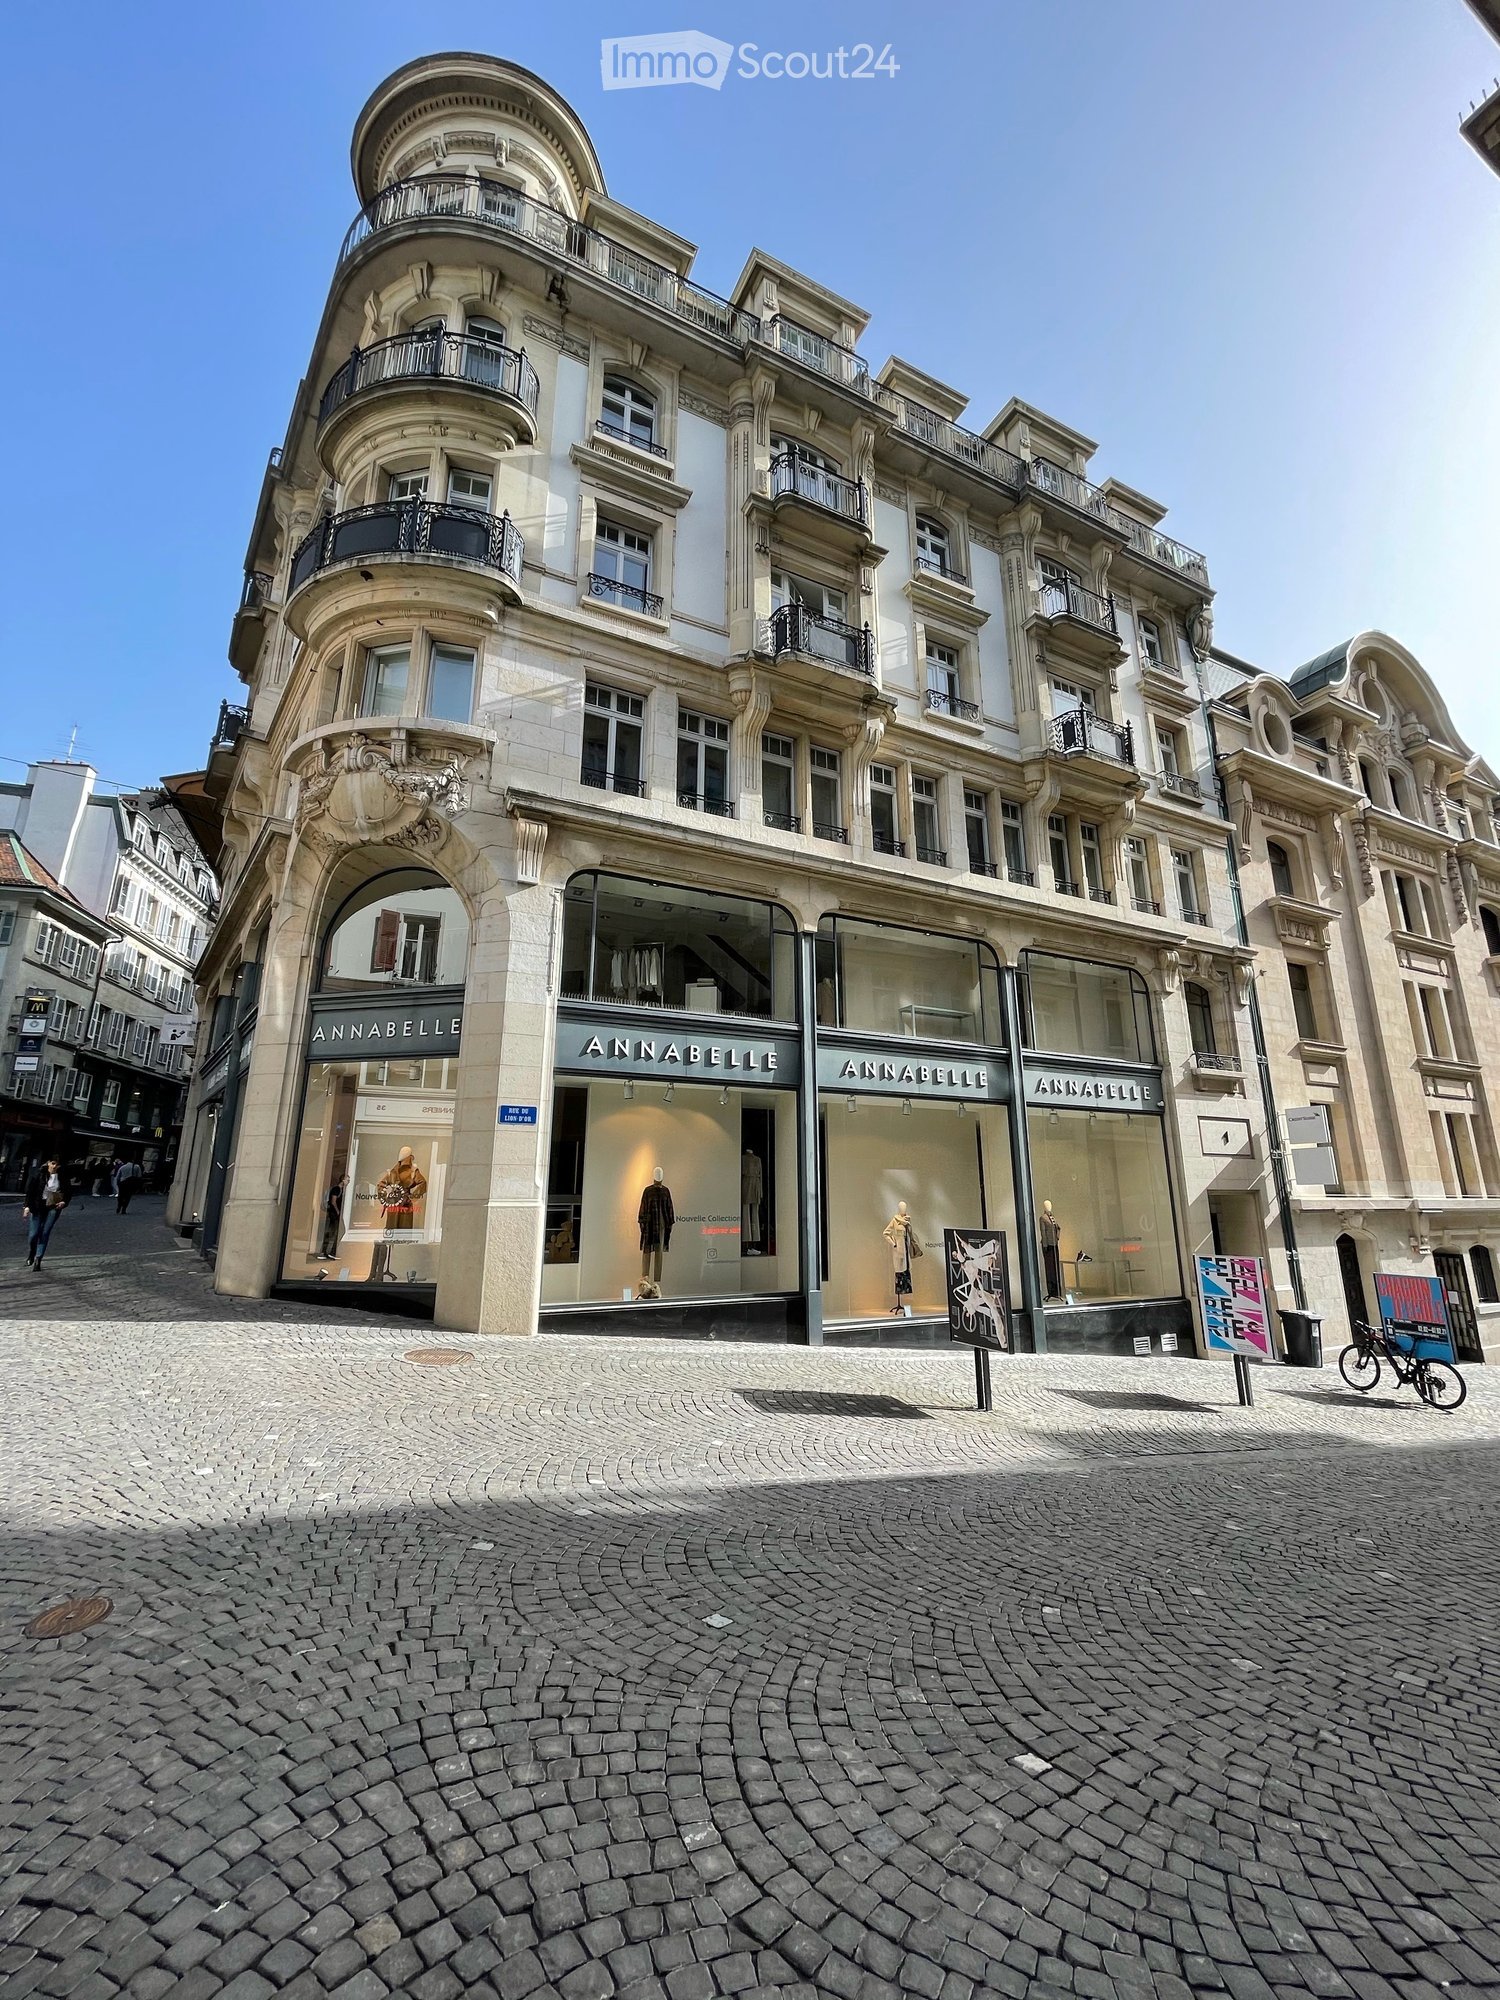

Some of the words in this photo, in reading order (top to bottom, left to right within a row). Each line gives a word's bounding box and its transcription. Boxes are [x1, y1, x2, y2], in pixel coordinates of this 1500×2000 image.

[312, 1018, 461, 1042] ANNABELLE
[586, 1035, 778, 1069] ANNABELLE
[844, 1058, 988, 1088] ANNABELLE
[1038, 1077, 1151, 1100] ANNABELLE
